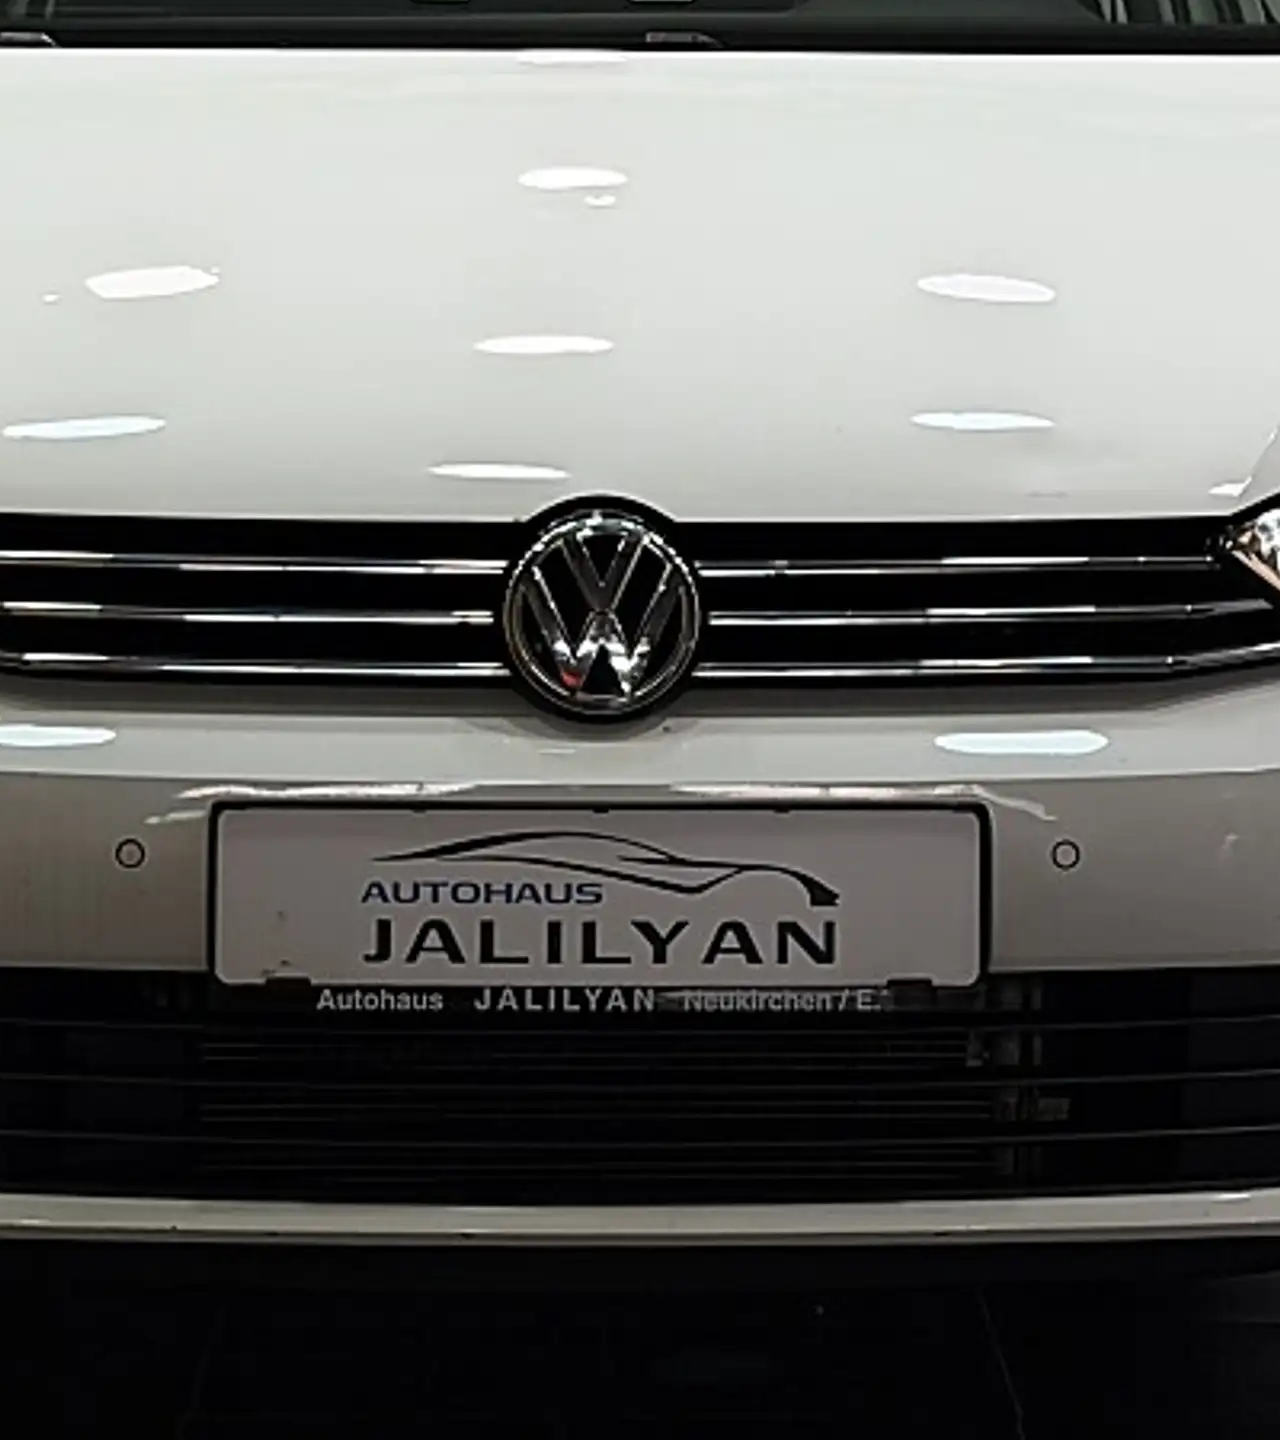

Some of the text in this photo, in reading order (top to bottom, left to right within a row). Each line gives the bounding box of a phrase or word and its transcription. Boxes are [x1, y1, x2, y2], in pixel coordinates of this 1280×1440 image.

[361, 881, 604, 905] AUTOHAUS
[363, 918, 837, 965] JALILYAN
[316, 988, 444, 1011] Autohaus
[473, 988, 655, 1011] JALILYAN
